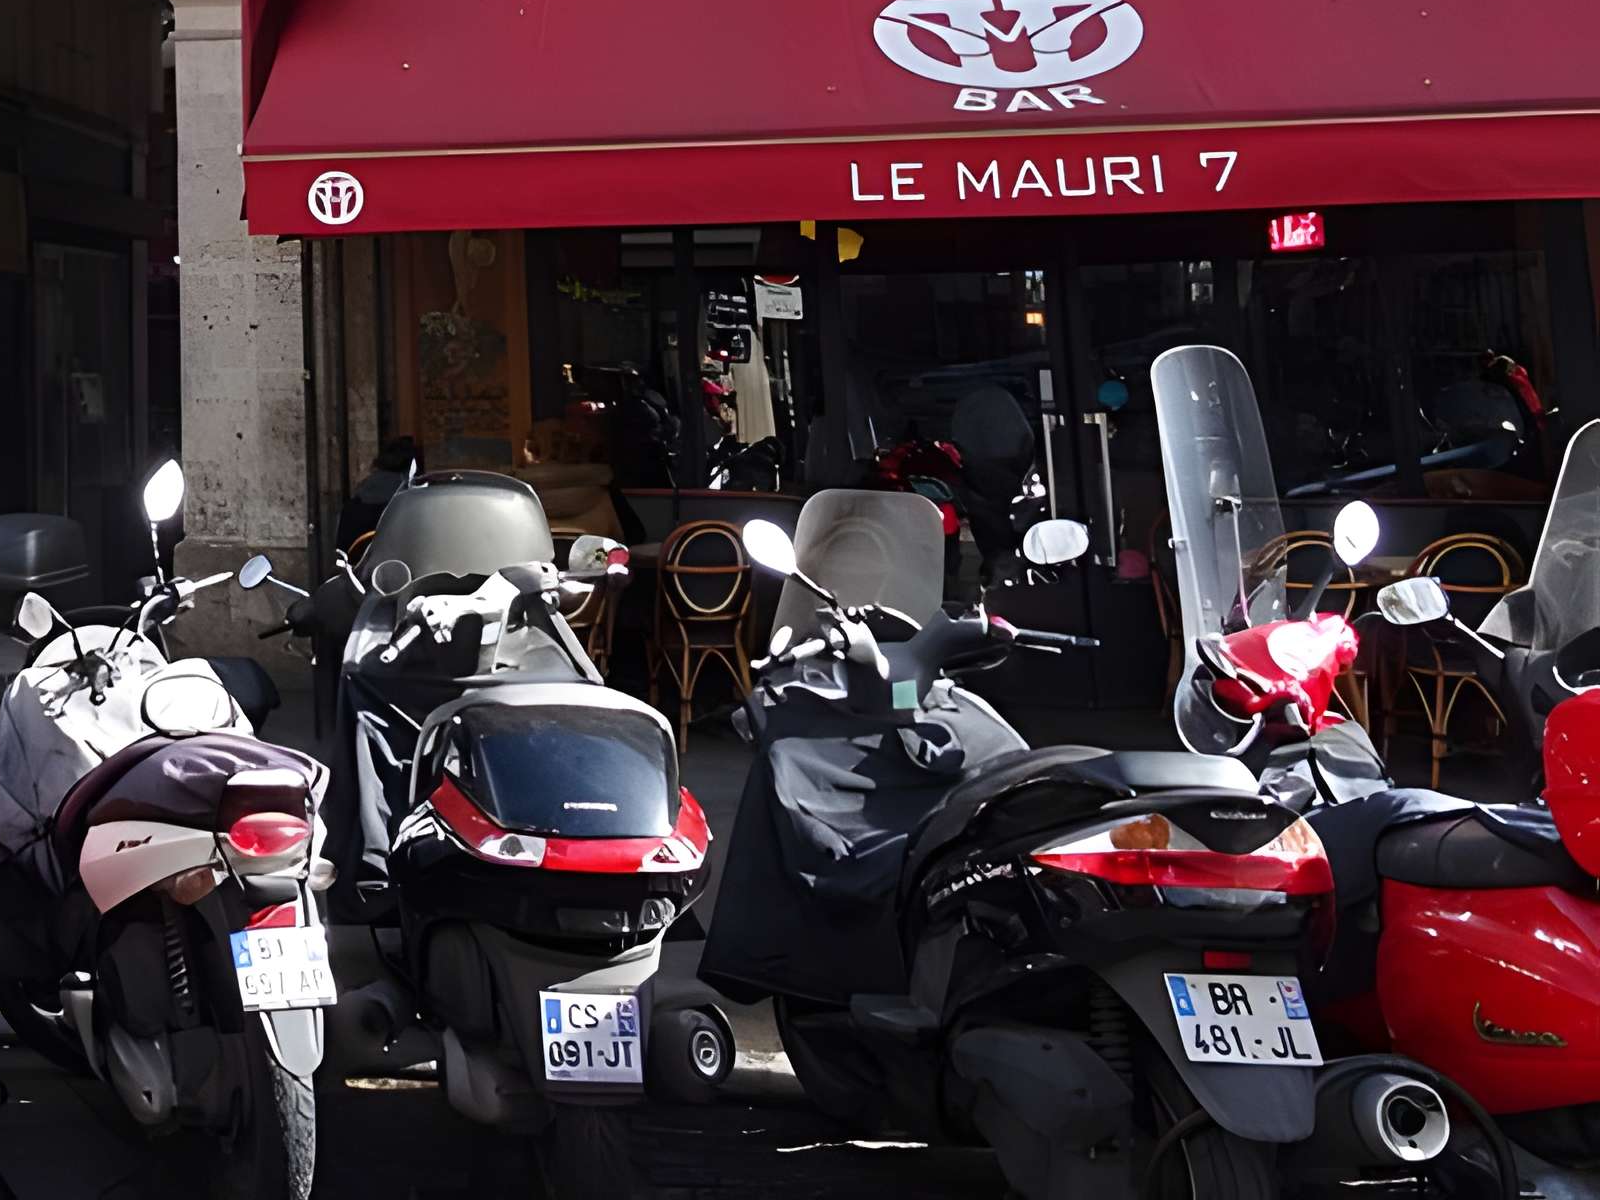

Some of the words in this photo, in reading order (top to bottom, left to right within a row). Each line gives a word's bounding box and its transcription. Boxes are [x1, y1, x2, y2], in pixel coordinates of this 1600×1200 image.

[953, 85, 1106, 113] BAR
[850, 161, 926, 202] LE
[956, 154, 1165, 200] MAURI
[1199, 150, 1238, 192] 7
